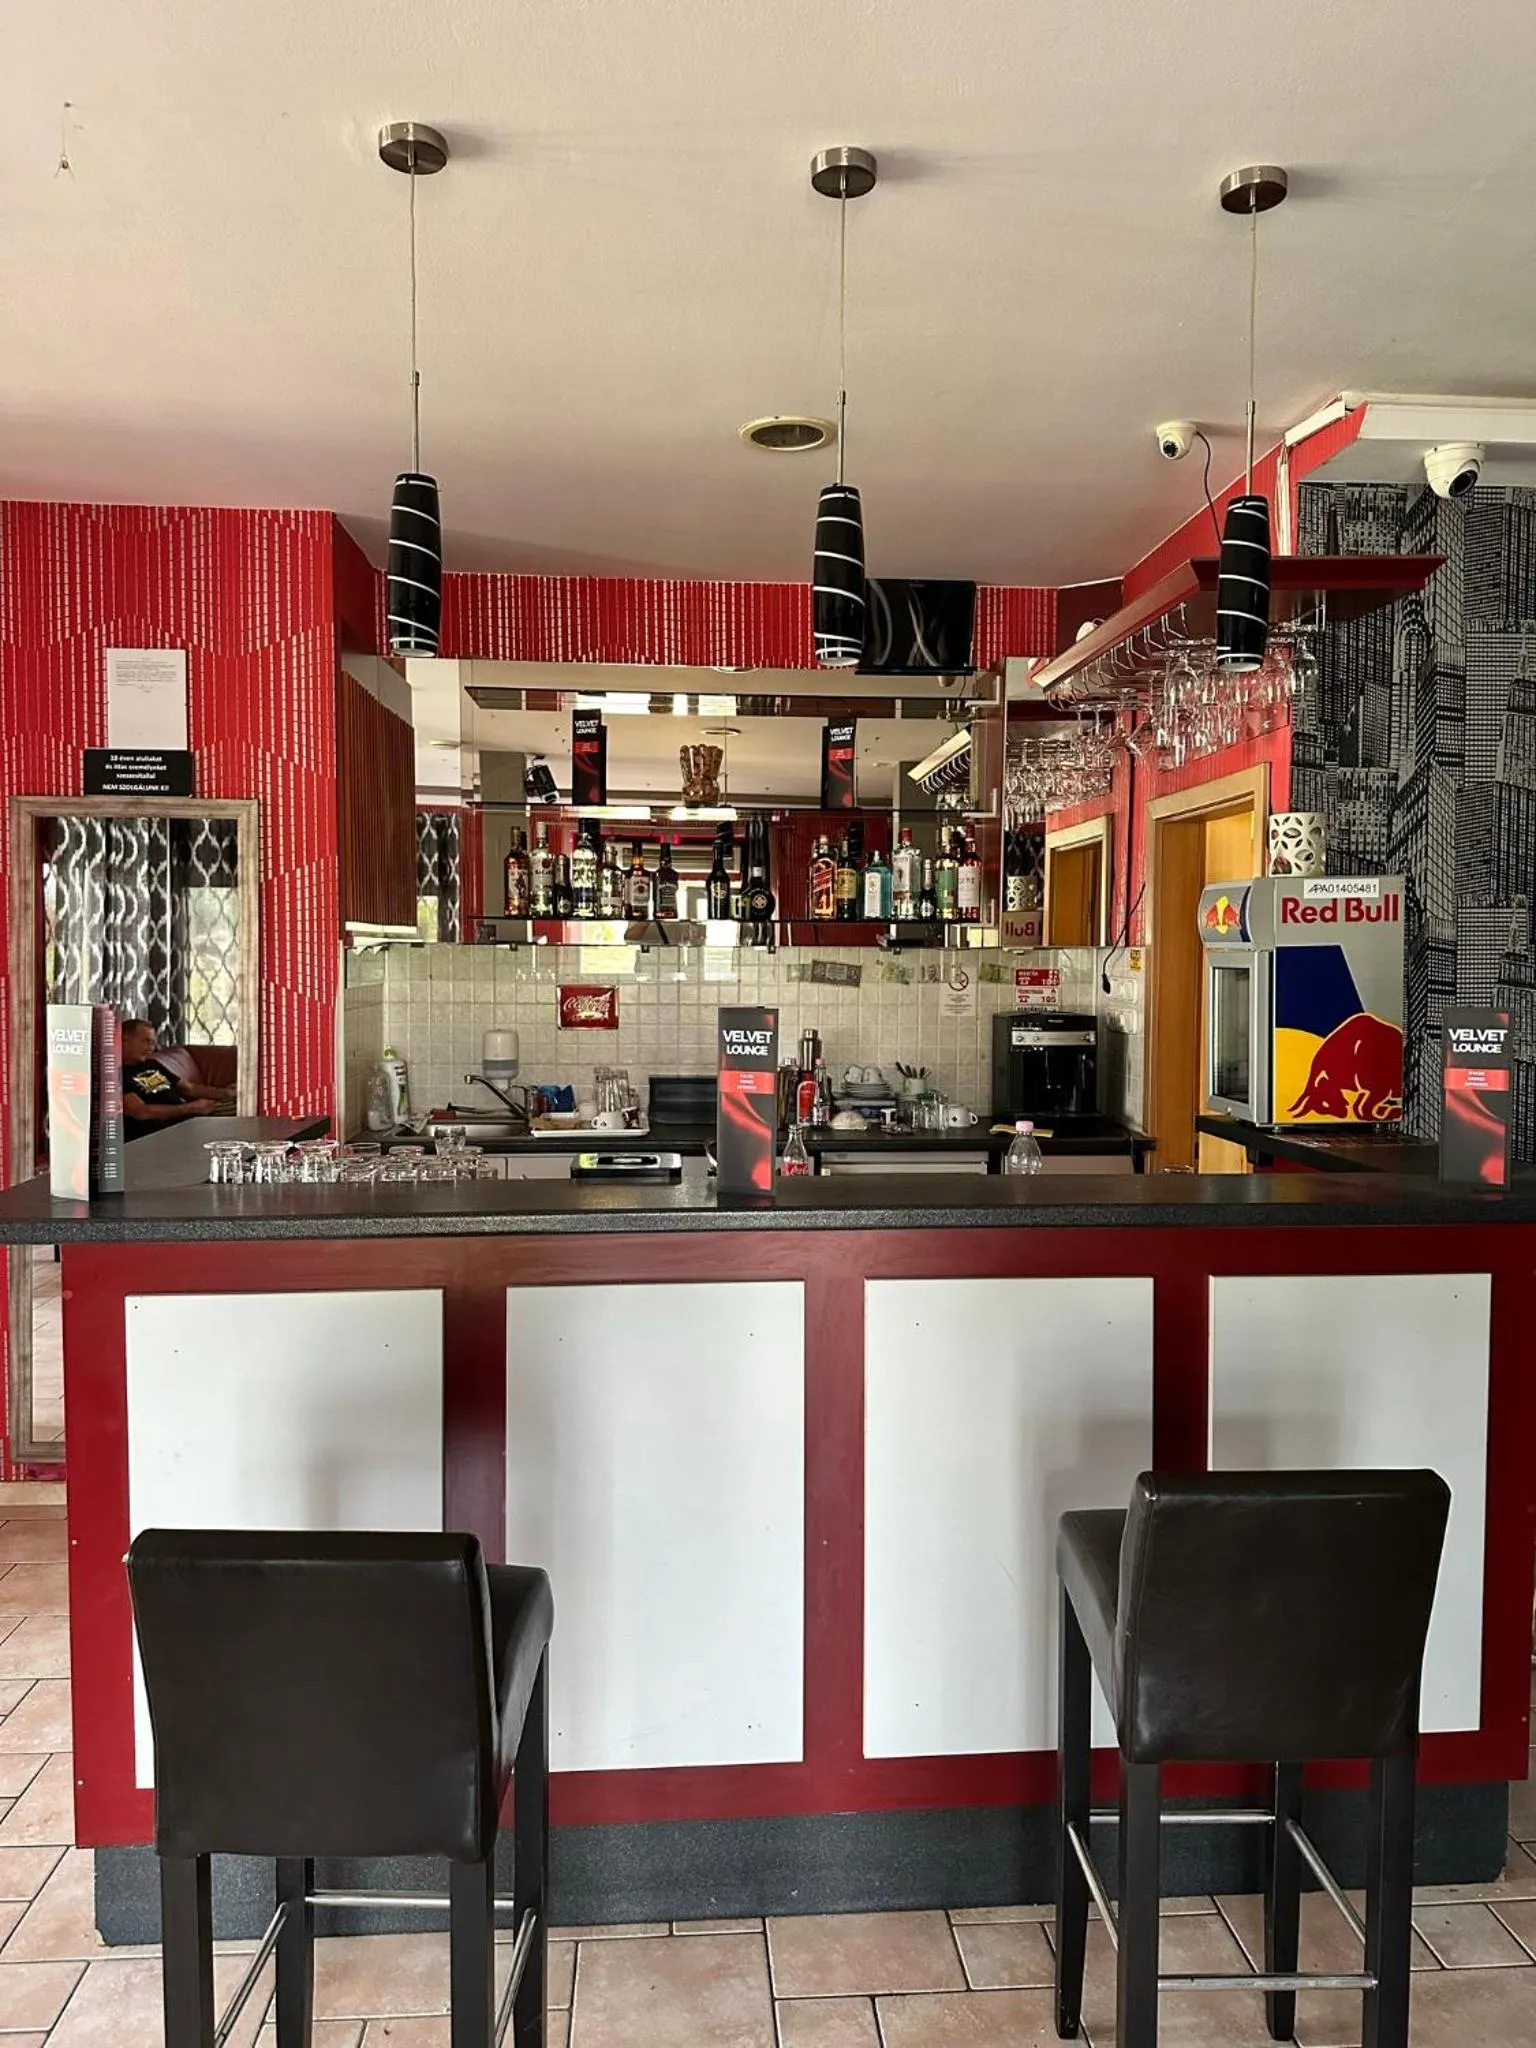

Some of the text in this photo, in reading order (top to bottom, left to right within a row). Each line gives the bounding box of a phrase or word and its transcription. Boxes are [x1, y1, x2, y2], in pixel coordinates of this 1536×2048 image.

[1281, 894, 1399, 924] Red Bull
[49, 1029, 88, 1043] VELVET
[722, 1029, 774, 1044] VELVET
[1447, 1028, 1509, 1042] VELVET
[726, 1044, 769, 1056] LOUNGE
[1452, 1042, 1503, 1054] LOUNGE
